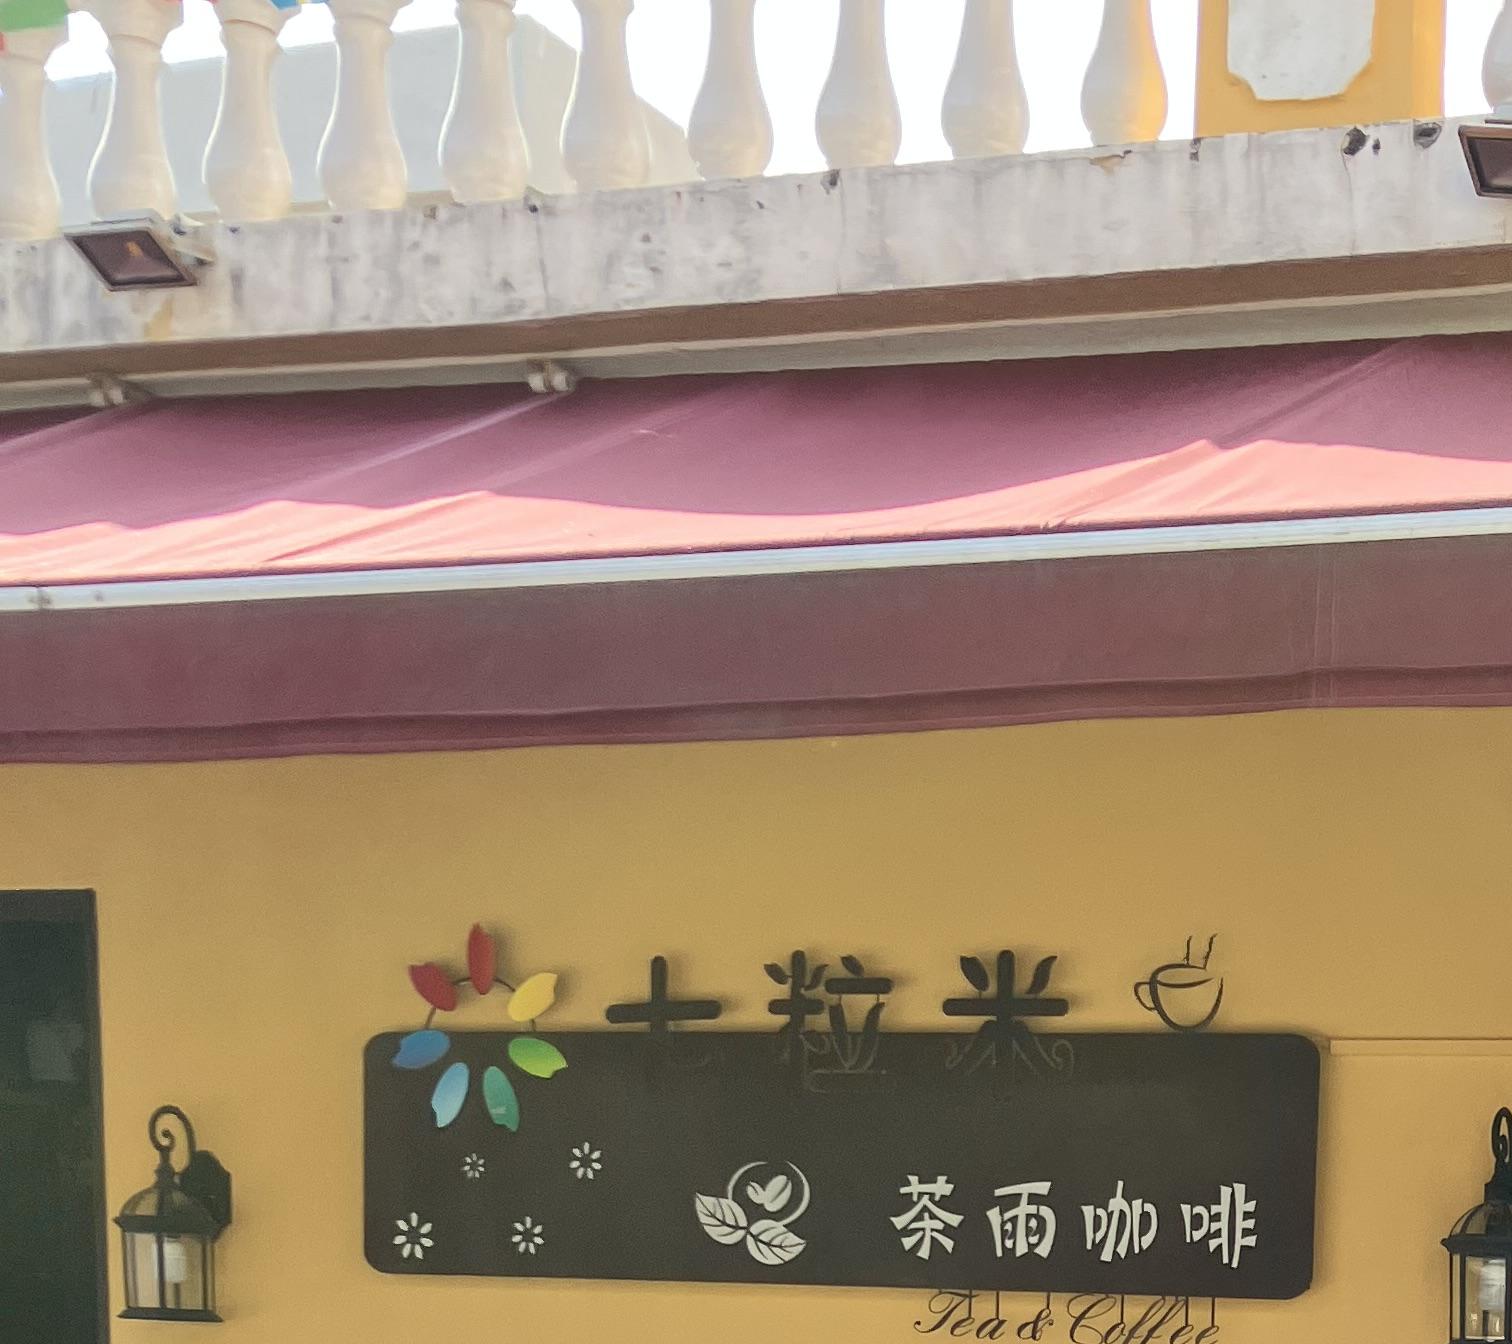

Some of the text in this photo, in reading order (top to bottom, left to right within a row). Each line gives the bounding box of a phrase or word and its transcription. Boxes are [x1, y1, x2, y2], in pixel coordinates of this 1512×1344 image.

[889, 1175, 1259, 1268] 茶雨咖啡
[914, 1290, 1007, 1341] Tea
[1016, 1307, 1055, 1343] &
